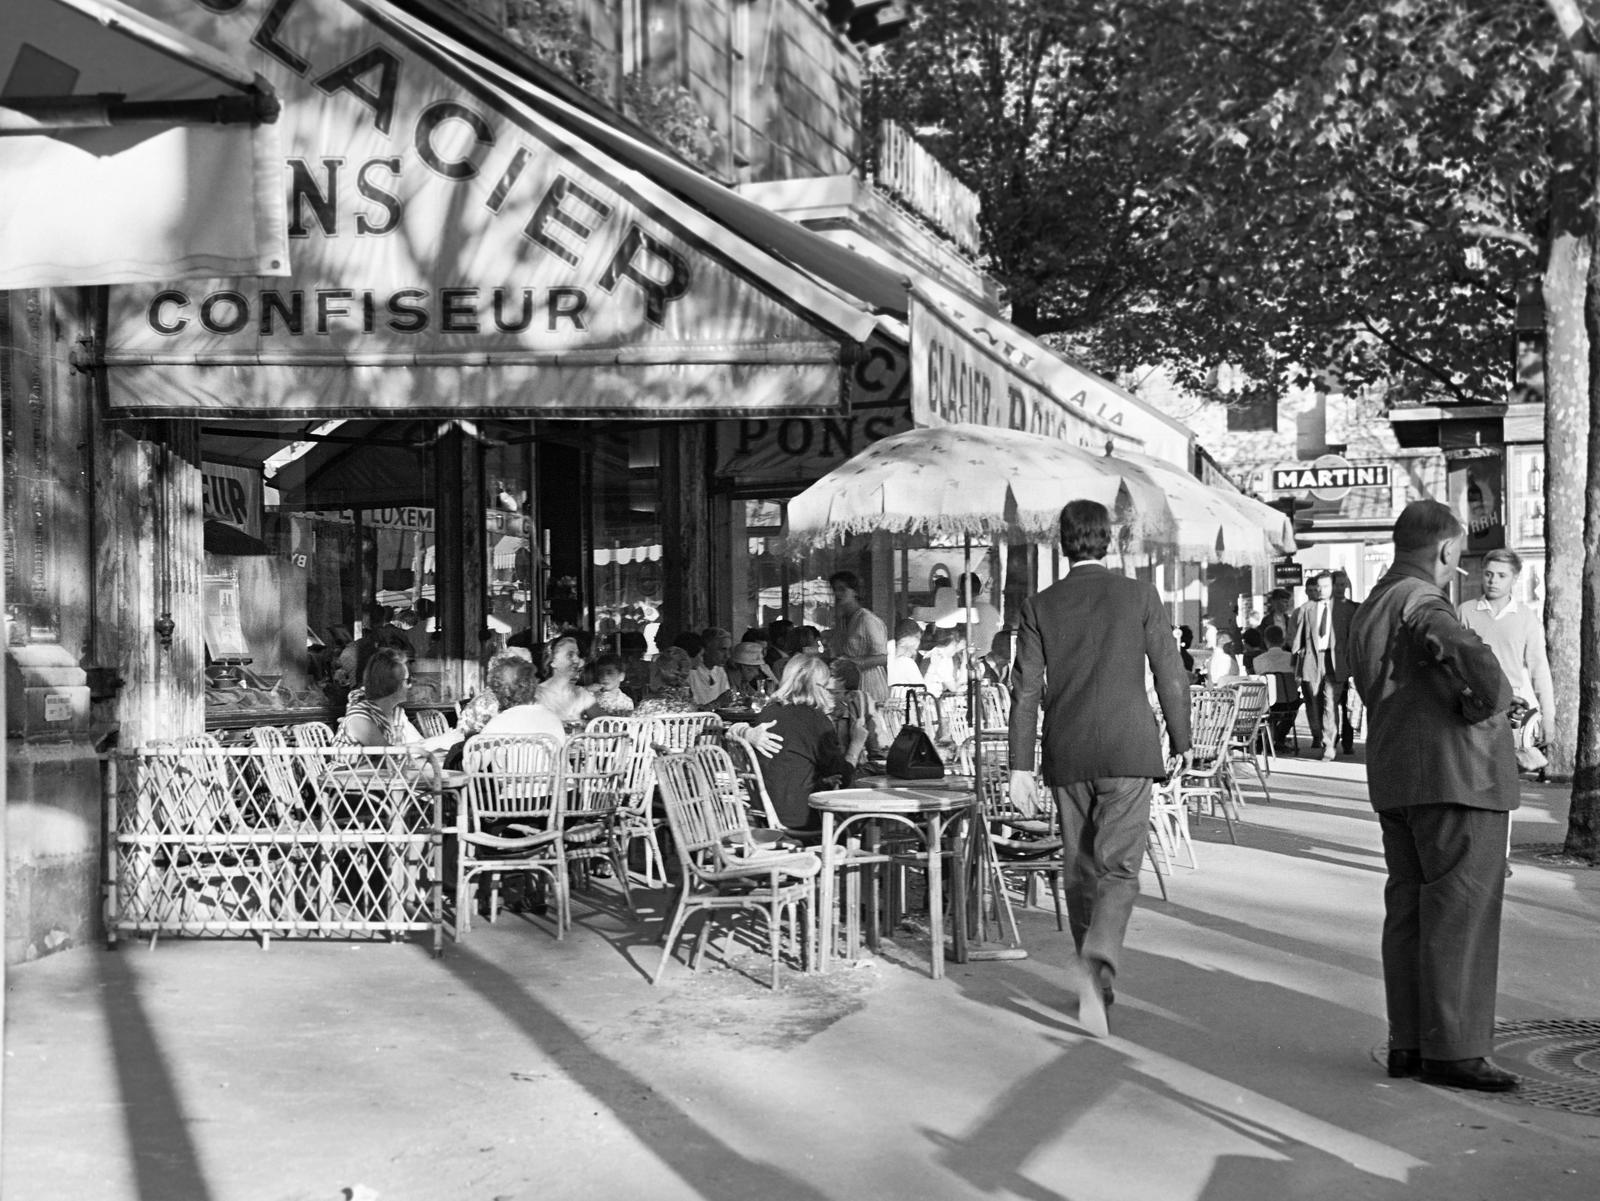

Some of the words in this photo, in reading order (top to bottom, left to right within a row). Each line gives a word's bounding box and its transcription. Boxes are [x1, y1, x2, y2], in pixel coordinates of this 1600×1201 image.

[193, 0, 693, 329] LACIER
[147, 287, 588, 334] CONFISEUR
[1278, 468, 1383, 488] MARTINI
